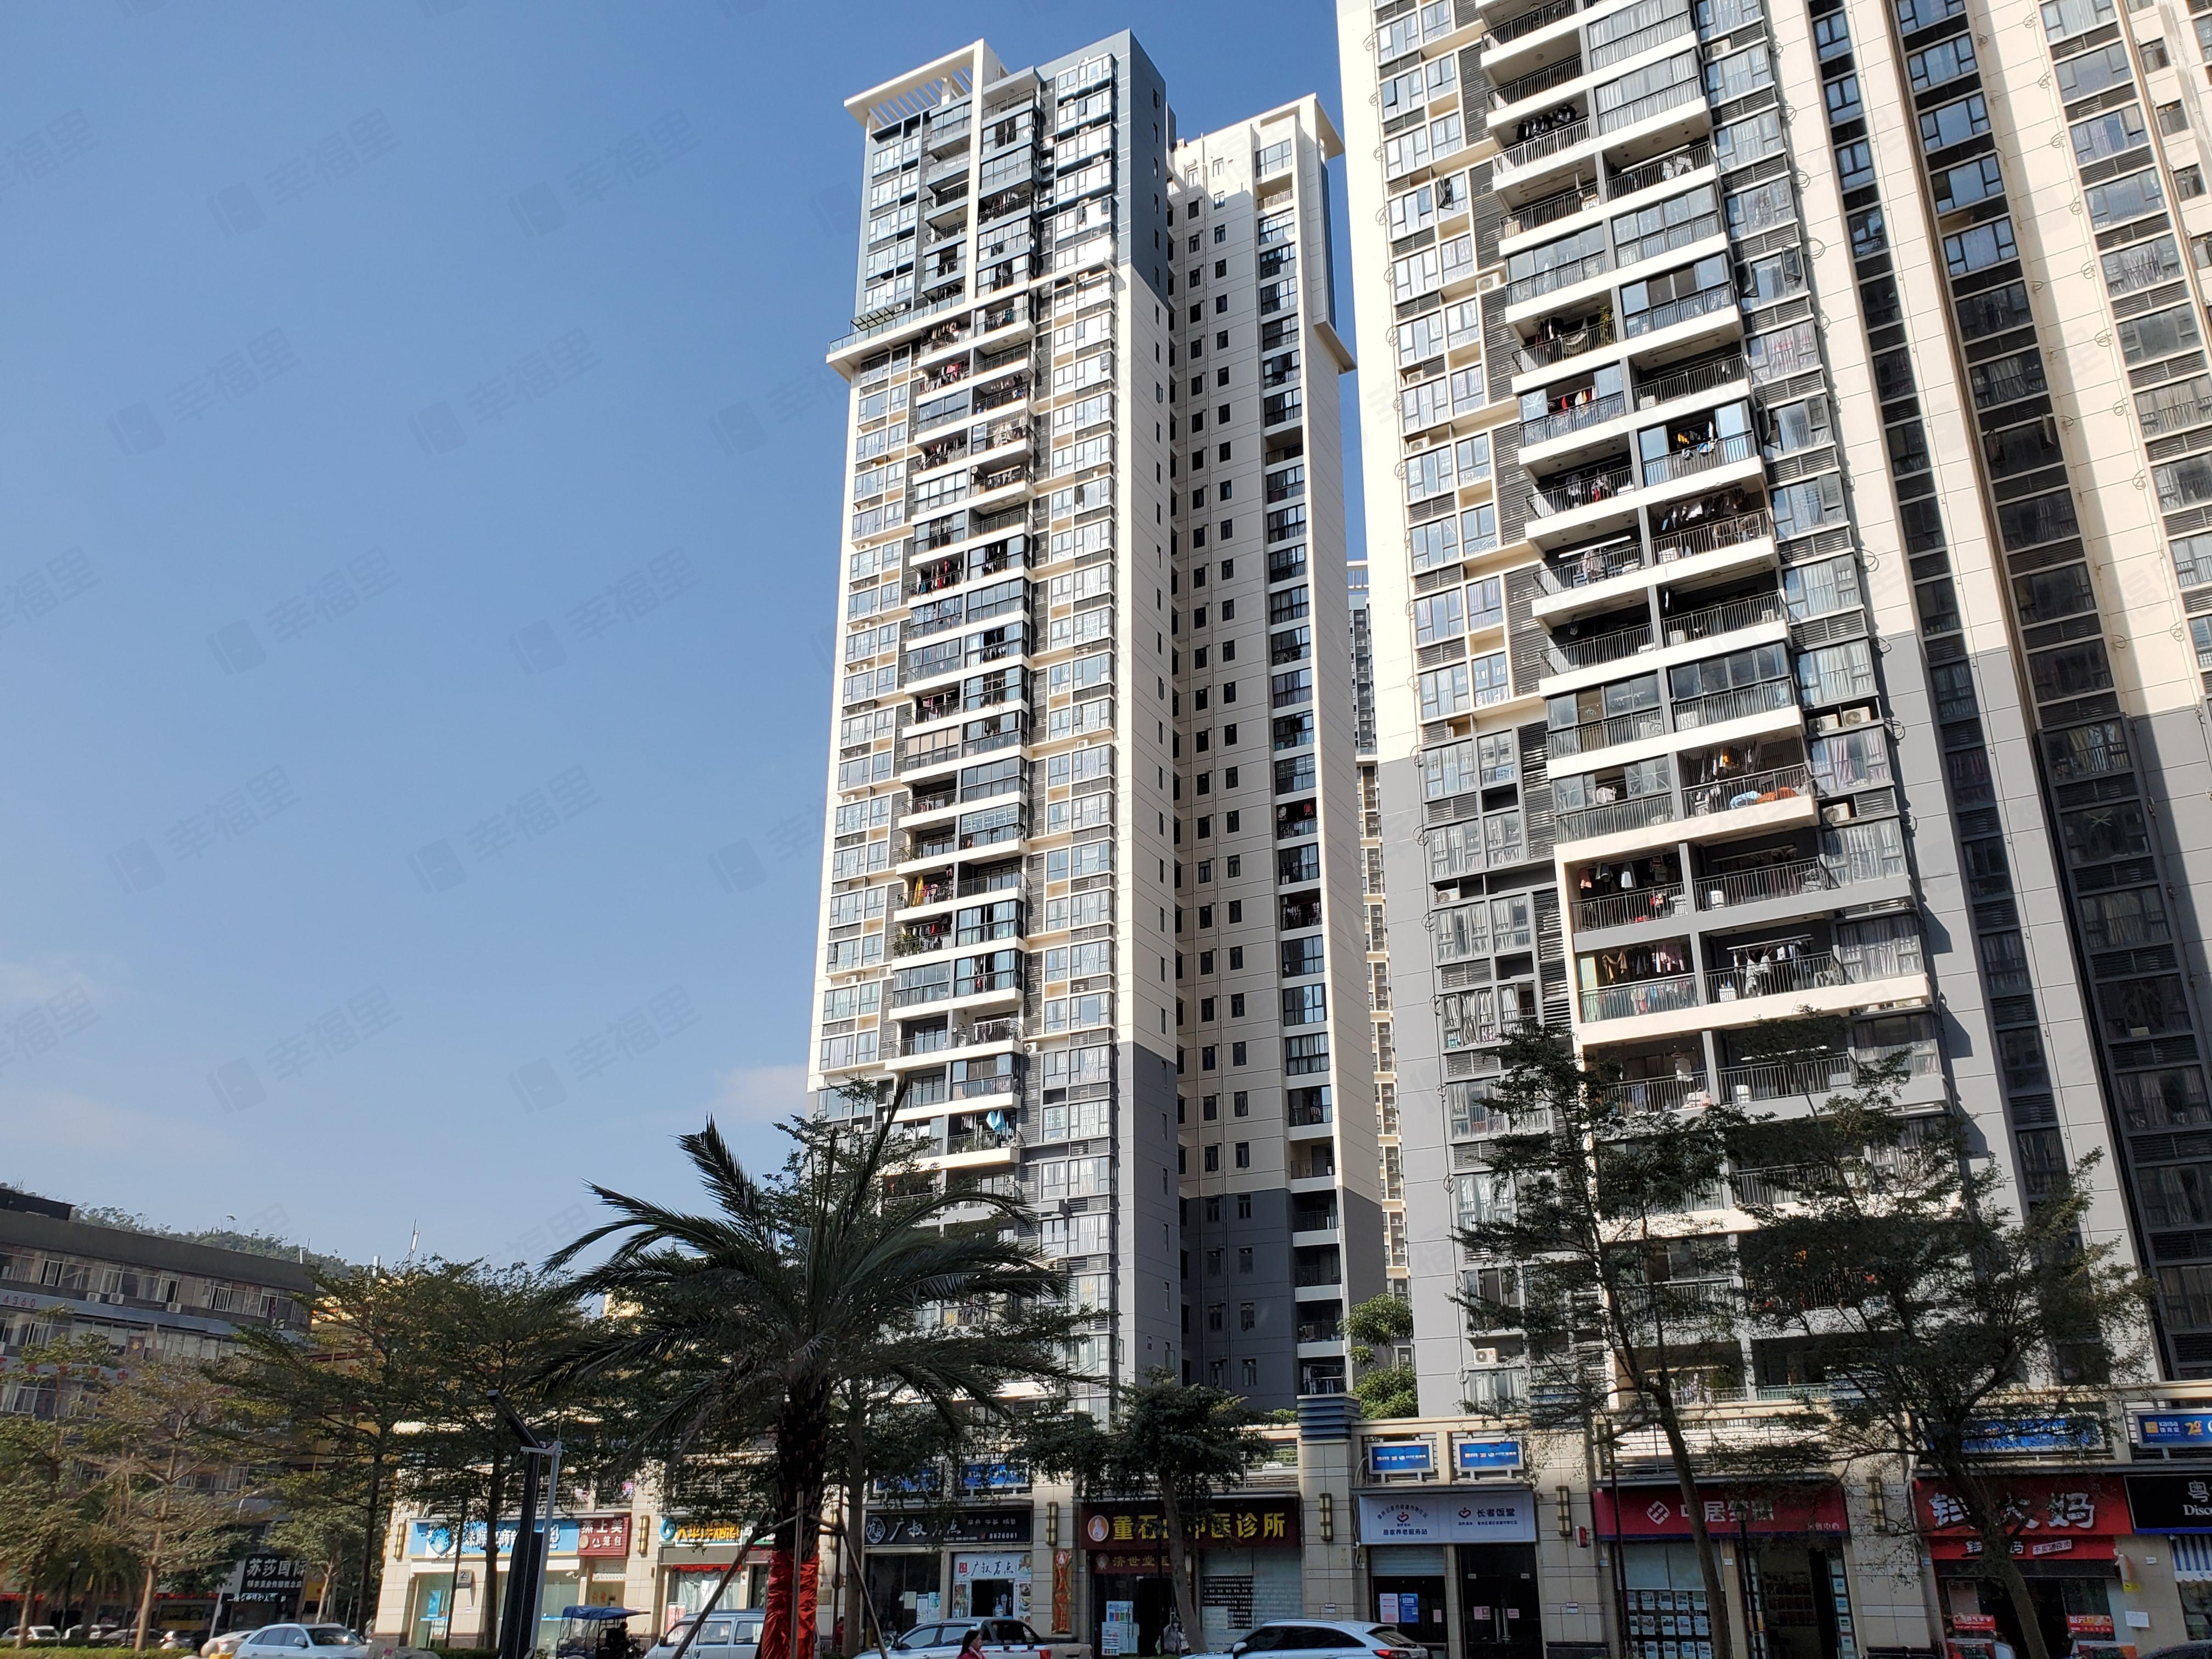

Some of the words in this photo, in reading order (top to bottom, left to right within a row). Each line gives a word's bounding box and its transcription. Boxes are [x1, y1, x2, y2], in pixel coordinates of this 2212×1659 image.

[3, 1295, 36, 1307] 4360
[2188, 1480, 2212, 1502] 粤
[1477, 1508, 1515, 1517] 长者饭堂
[2183, 1504, 2212, 1516] Disc
